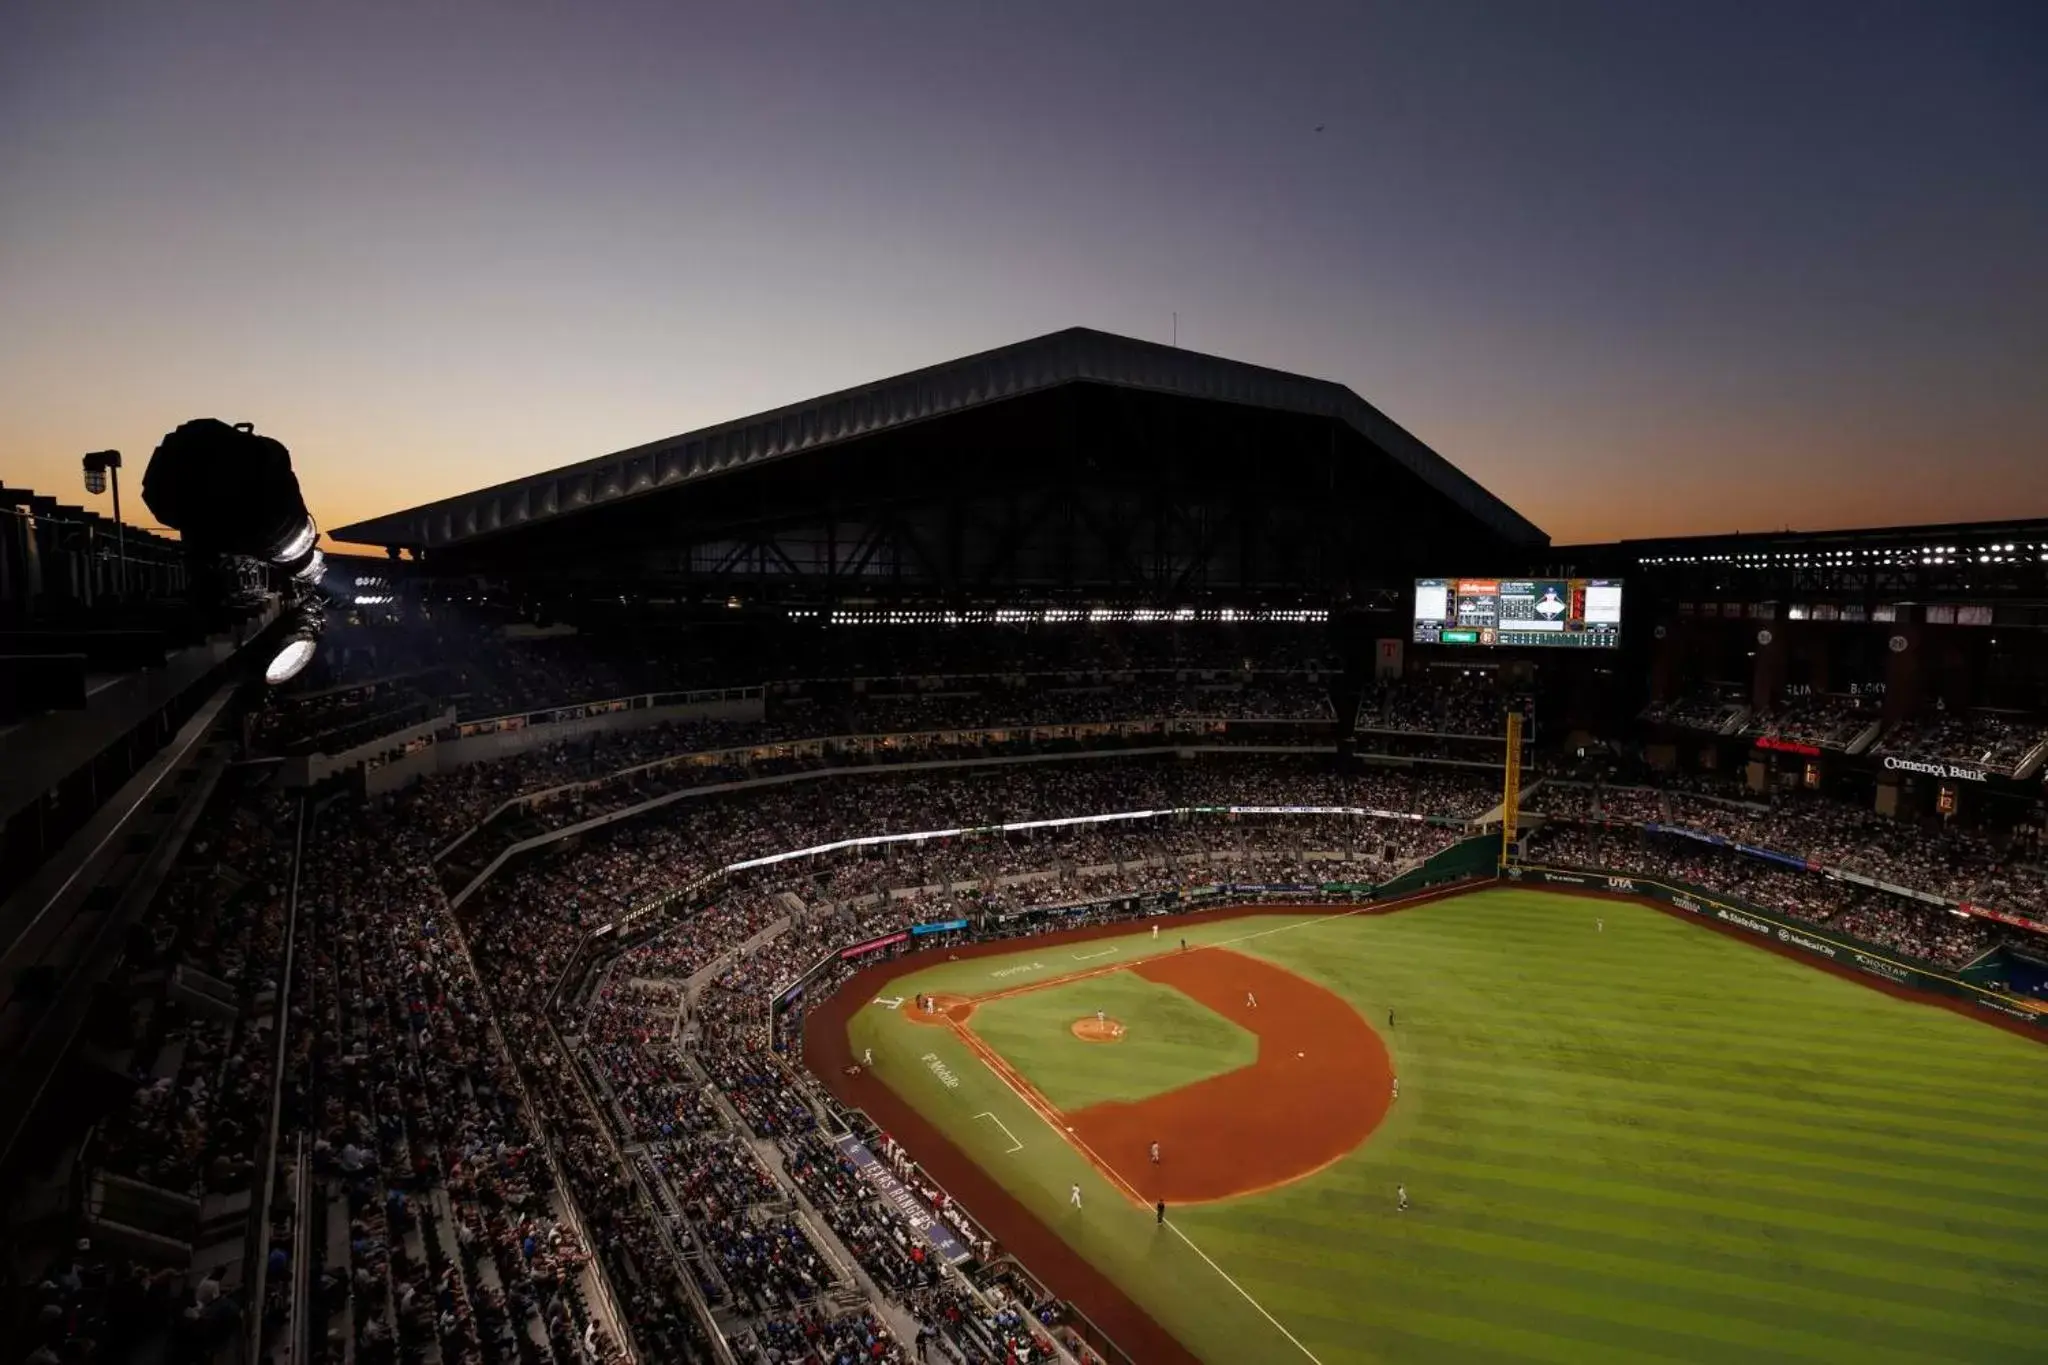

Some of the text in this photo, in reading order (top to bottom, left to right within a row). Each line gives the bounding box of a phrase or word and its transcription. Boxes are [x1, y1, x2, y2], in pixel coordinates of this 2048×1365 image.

[1949, 765, 1987, 782] Bank
[1608, 876, 1633, 889] UTA
[1791, 935, 1836, 958] Medical City
[863, 1159, 937, 1231] TEXAS RANGERS
